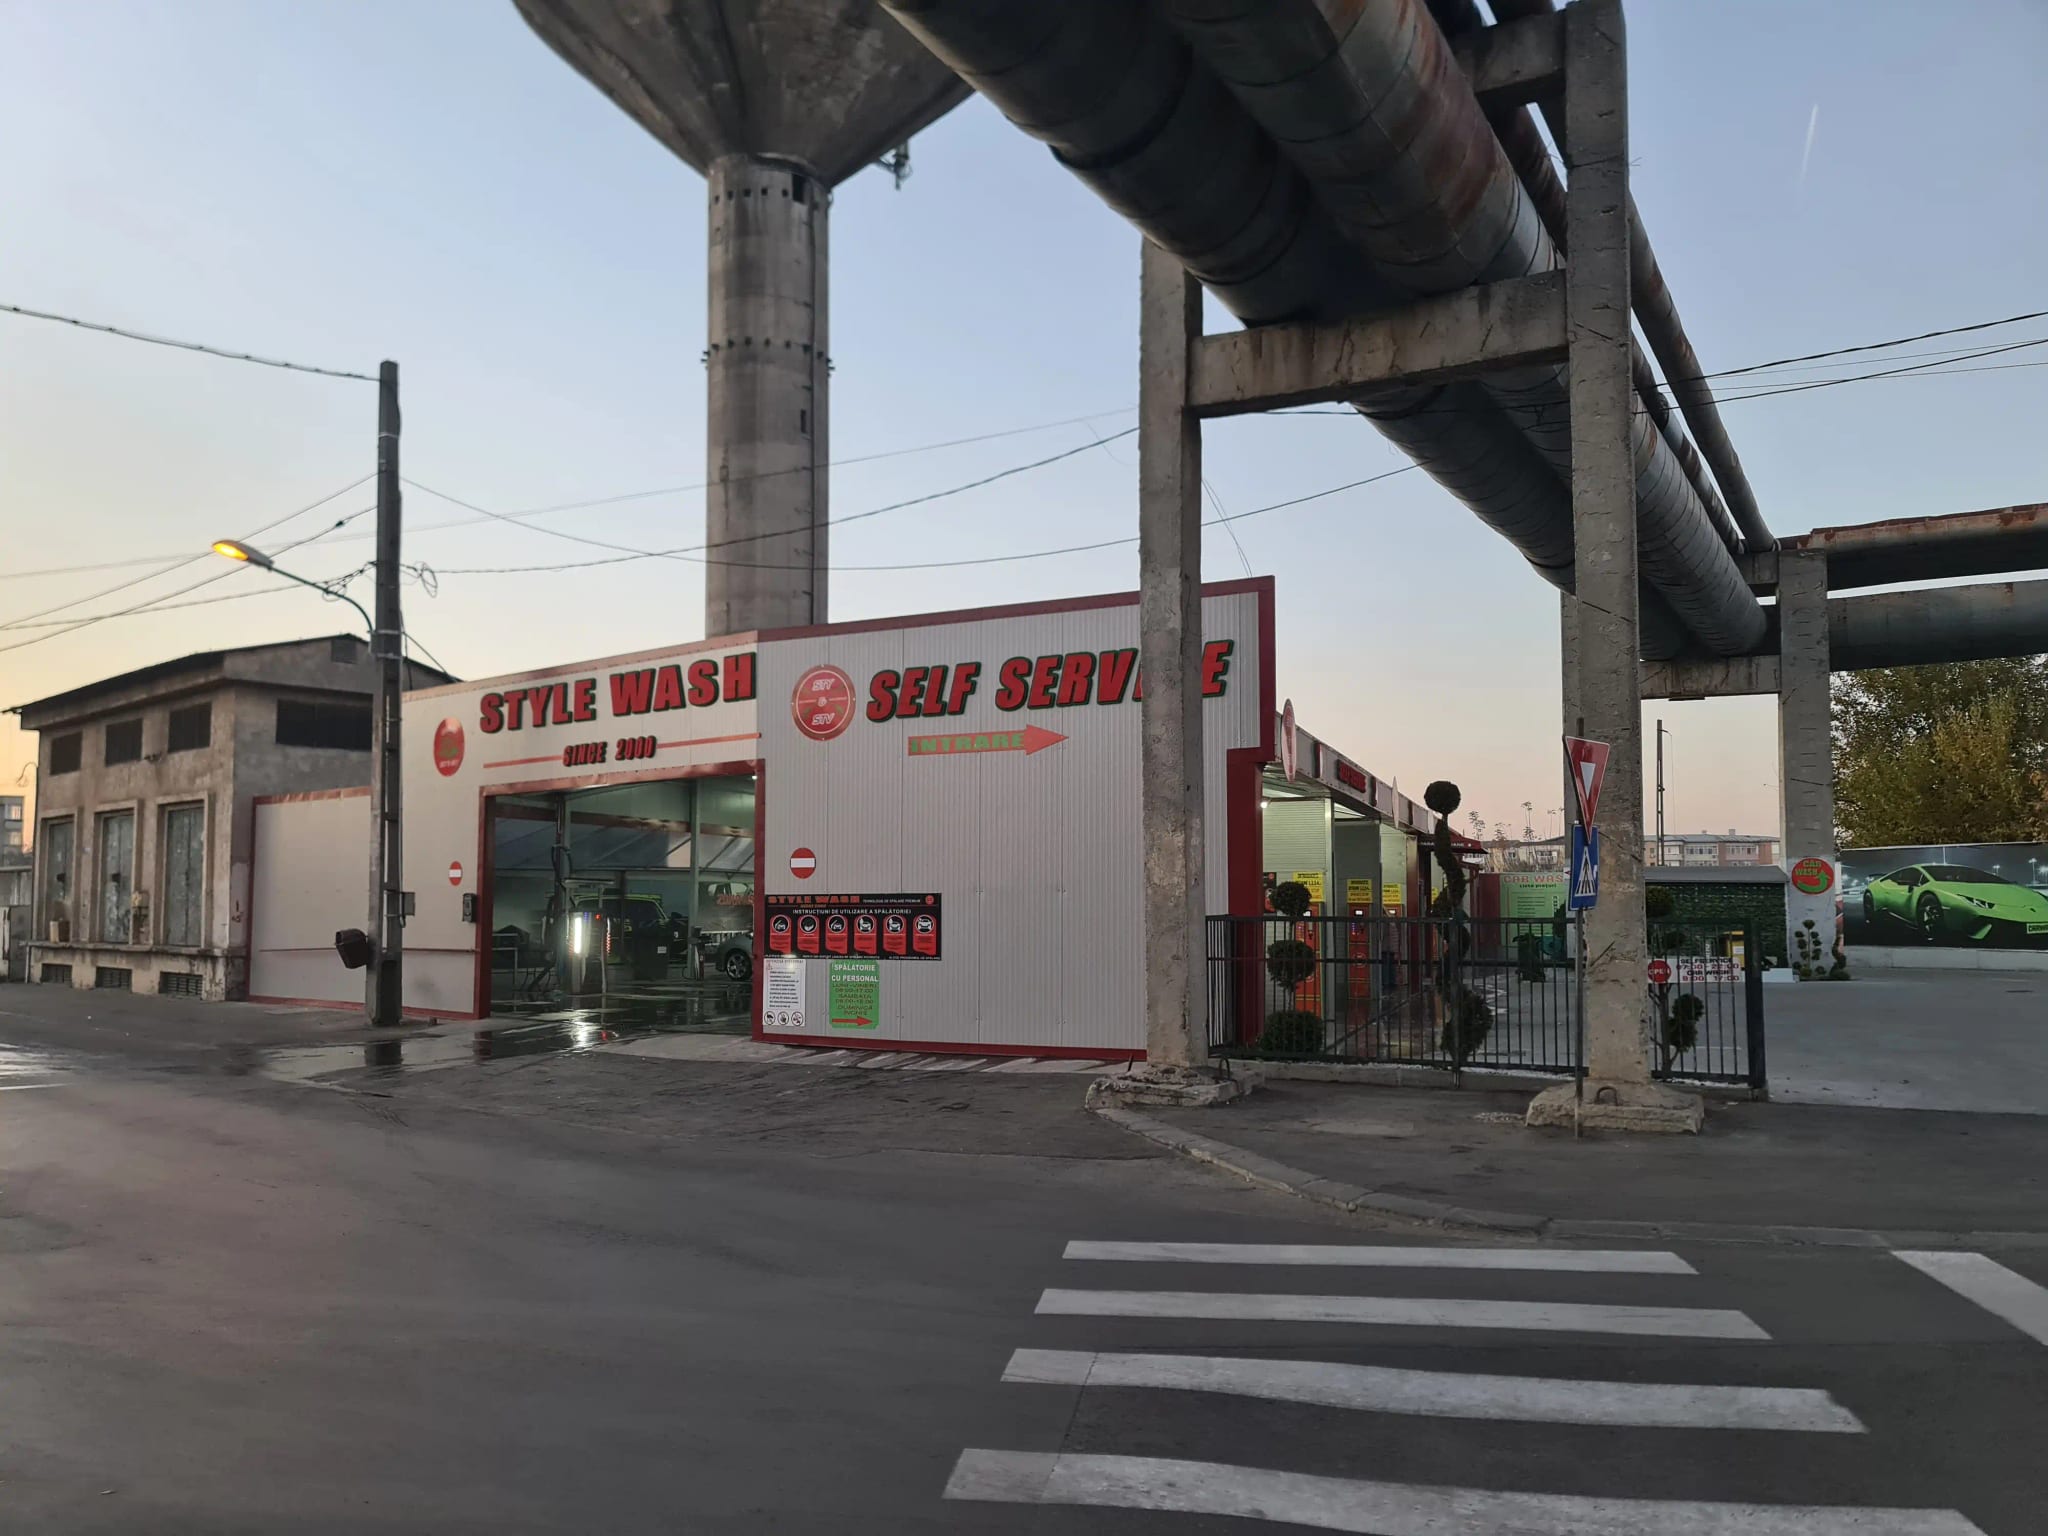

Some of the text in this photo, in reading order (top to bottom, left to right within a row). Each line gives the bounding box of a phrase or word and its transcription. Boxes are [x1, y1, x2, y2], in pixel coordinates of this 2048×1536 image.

[480, 652, 757, 733] STYLE WASH
[866, 640, 1234, 722] SELF SERVE
[563, 735, 657, 767] SINCE 2000
[911, 732, 1025, 753] INTRARE
[1503, 874, 1564, 883] CAR WAS
[768, 895, 860, 904] STYLE WASH
